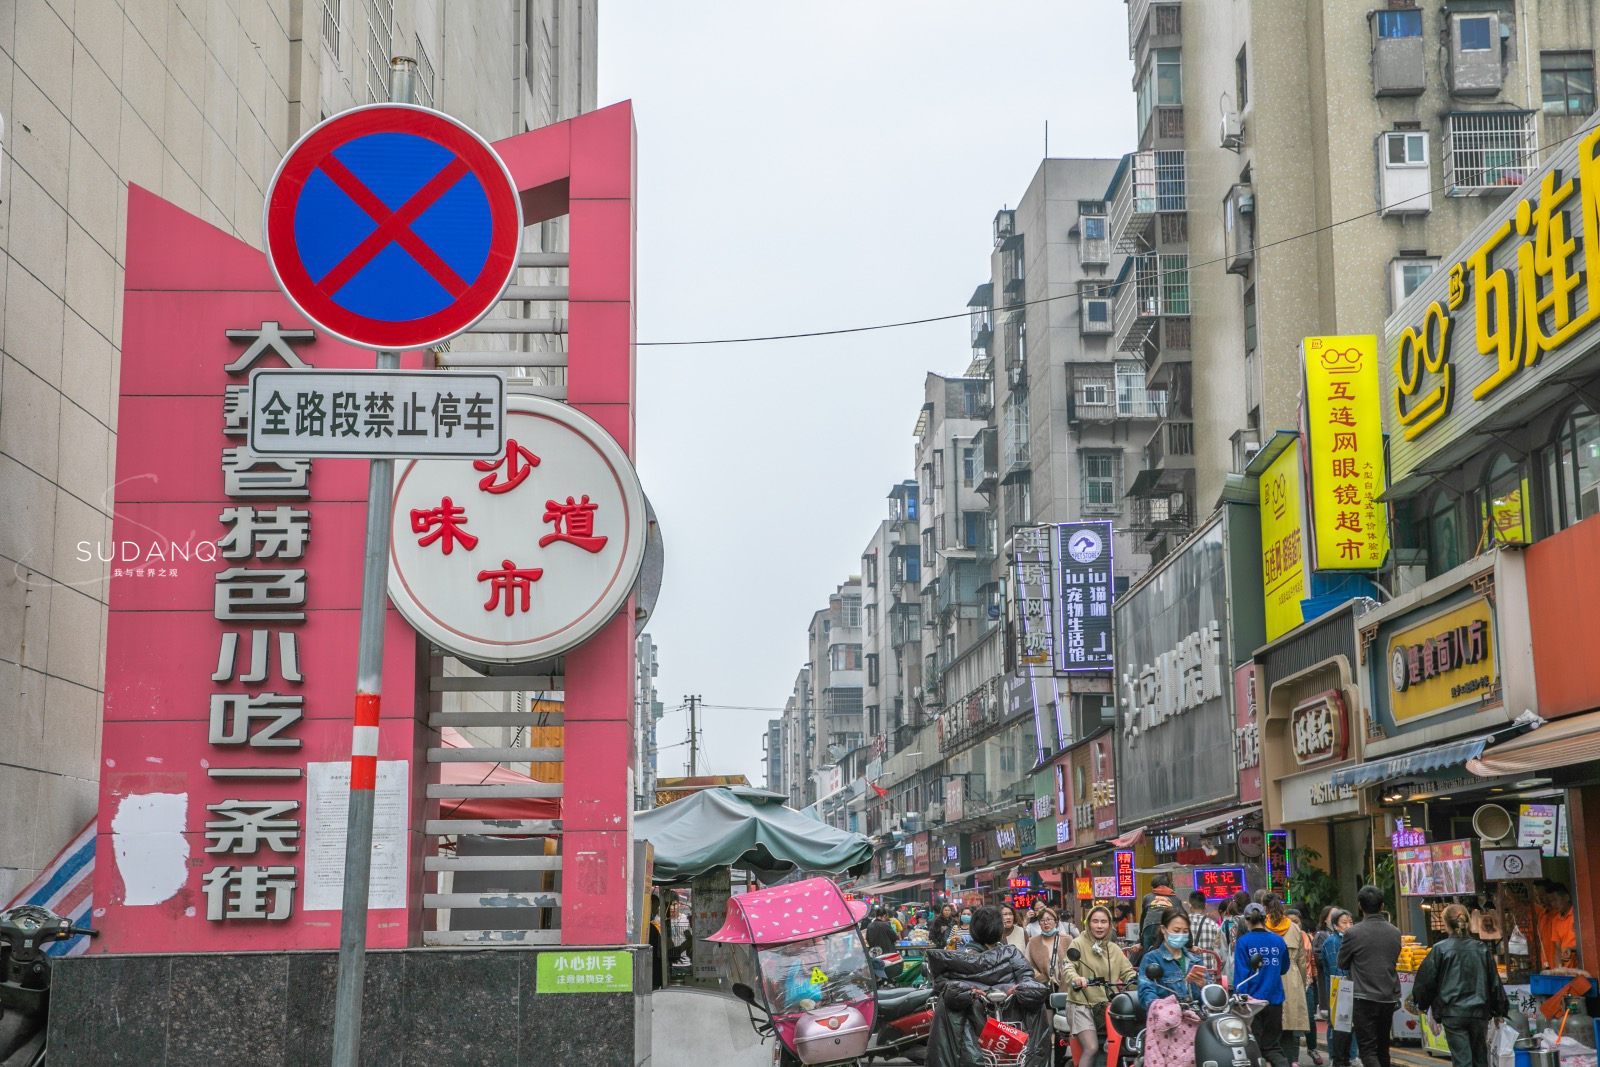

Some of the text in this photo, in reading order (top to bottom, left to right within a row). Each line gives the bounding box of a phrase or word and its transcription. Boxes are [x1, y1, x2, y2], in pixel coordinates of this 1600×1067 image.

[1467, 125, 1600, 400] 互连
[261, 390, 494, 439] 全路段禁止停车
[1328, 382, 1365, 560] 互连网眼镜超市
[1118, 853, 1133, 897] 精品坚果
[1204, 872, 1235, 885] 张记
[554, 956, 616, 971] 小心扒手
[998, 1022, 1018, 1035] HONOR
